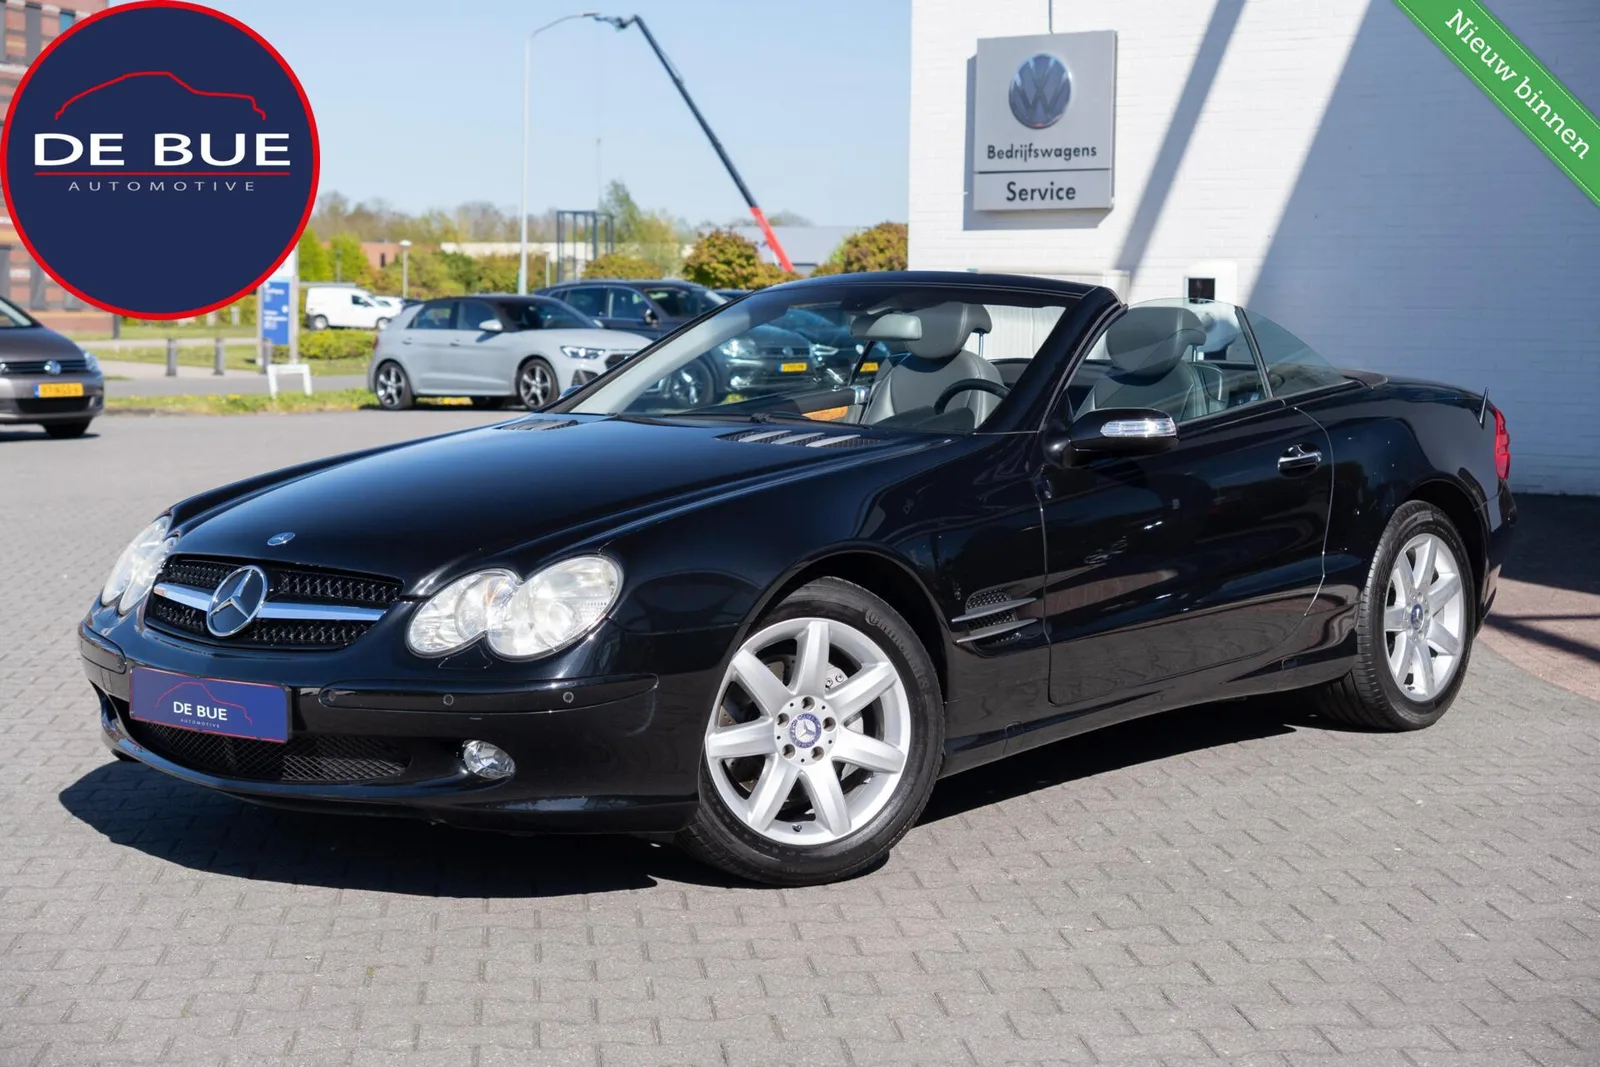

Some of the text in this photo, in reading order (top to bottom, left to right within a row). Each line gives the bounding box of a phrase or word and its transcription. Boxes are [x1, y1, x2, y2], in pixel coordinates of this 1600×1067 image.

[987, 142, 1097, 162] Bedrijfswagens
[1006, 181, 1076, 202] Service
[173, 701, 228, 721] DE BUE
